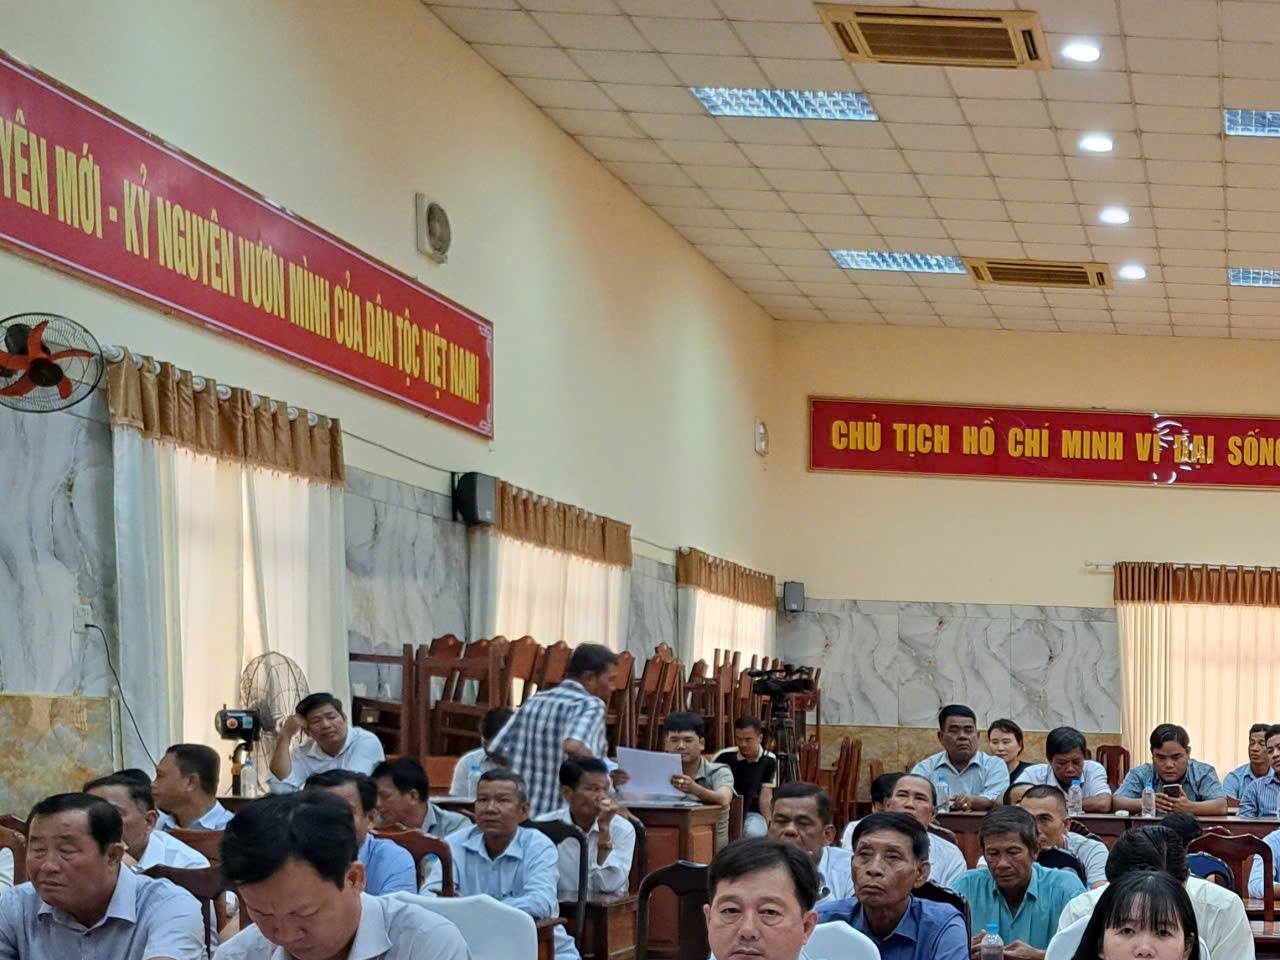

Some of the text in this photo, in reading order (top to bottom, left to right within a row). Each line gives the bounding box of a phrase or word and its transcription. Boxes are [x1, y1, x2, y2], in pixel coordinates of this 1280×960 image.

[55, 142, 103, 240] MỚI
[109, 205, 118, 223] -
[124, 162, 150, 261] KỶ
[157, 208, 235, 297] NGUYÊN
[239, 236, 286, 319] VƯƠN
[289, 255, 331, 339] MÌNH
[334, 270, 363, 353] CỦA
[366, 293, 394, 367] DÂN
[396, 308, 420, 386] TỘC
[423, 323, 447, 399] VIỆT
[450, 342, 480, 405] NAM!
[831, 414, 882, 452] CHỦ
[893, 421, 950, 458] TỊCH
[962, 415, 995, 456] HỒ
[1007, 422, 1049, 458] CHÍ
[1062, 430, 1123, 461] MINH
